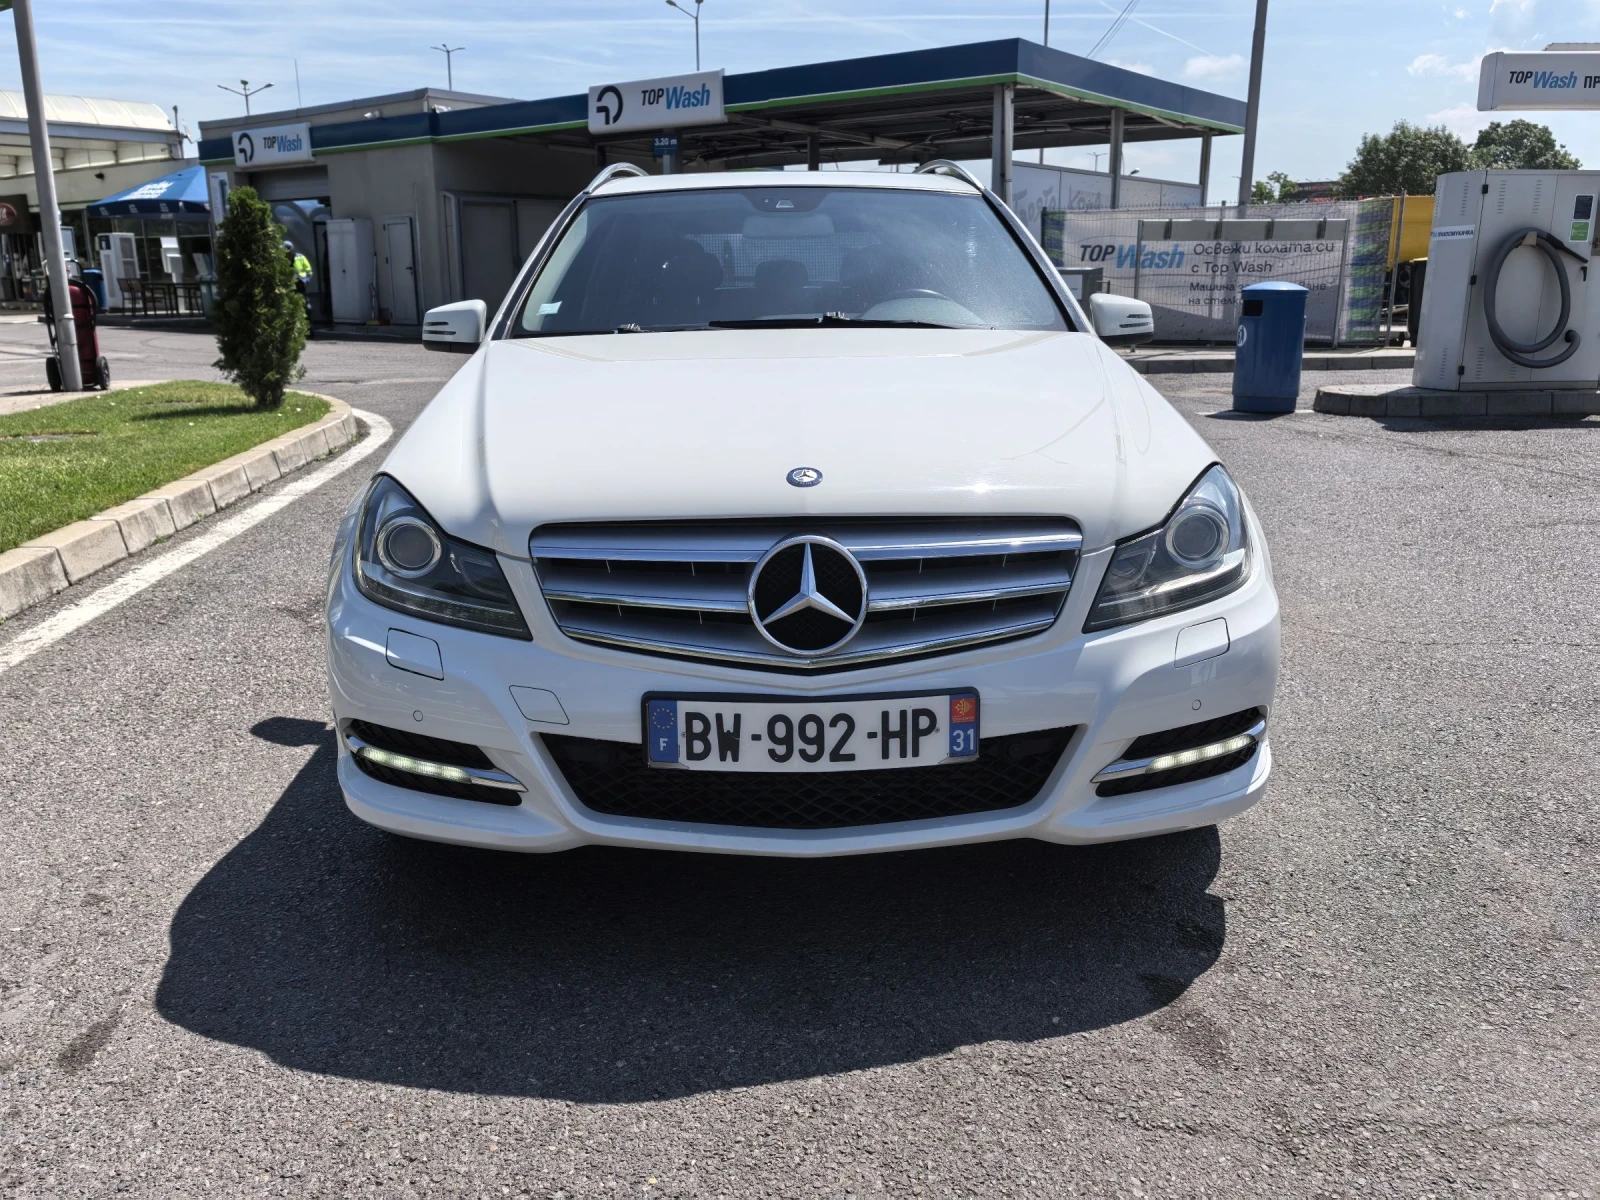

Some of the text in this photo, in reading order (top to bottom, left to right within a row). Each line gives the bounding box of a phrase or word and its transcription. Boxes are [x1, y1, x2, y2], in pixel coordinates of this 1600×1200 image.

[1233, 261, 1273, 273] Wash
[1189, 282, 1235, 292] Машина
[659, 737, 669, 751] F
[952, 729, 974, 751] 31
